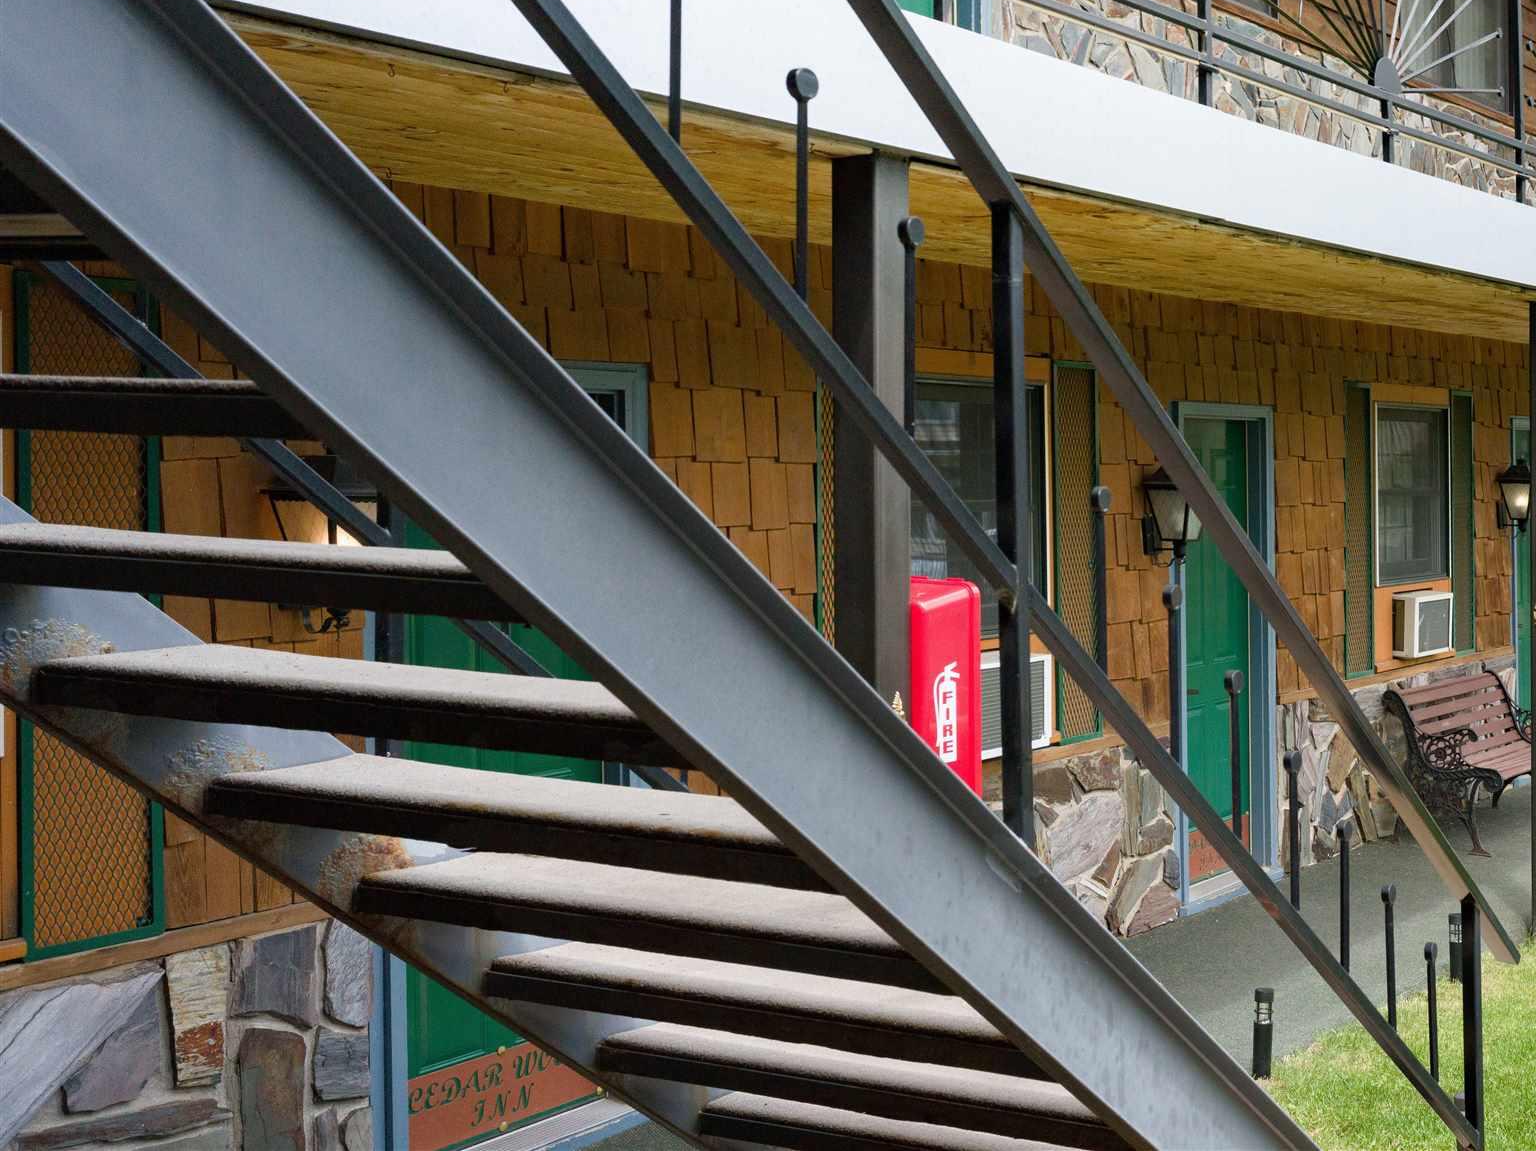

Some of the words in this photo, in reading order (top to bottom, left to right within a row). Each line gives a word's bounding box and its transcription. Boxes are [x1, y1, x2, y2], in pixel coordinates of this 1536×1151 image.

[942, 690, 953, 753] FIRE
[408, 1062, 503, 1115] CEDAR
[471, 1083, 534, 1127] INN
